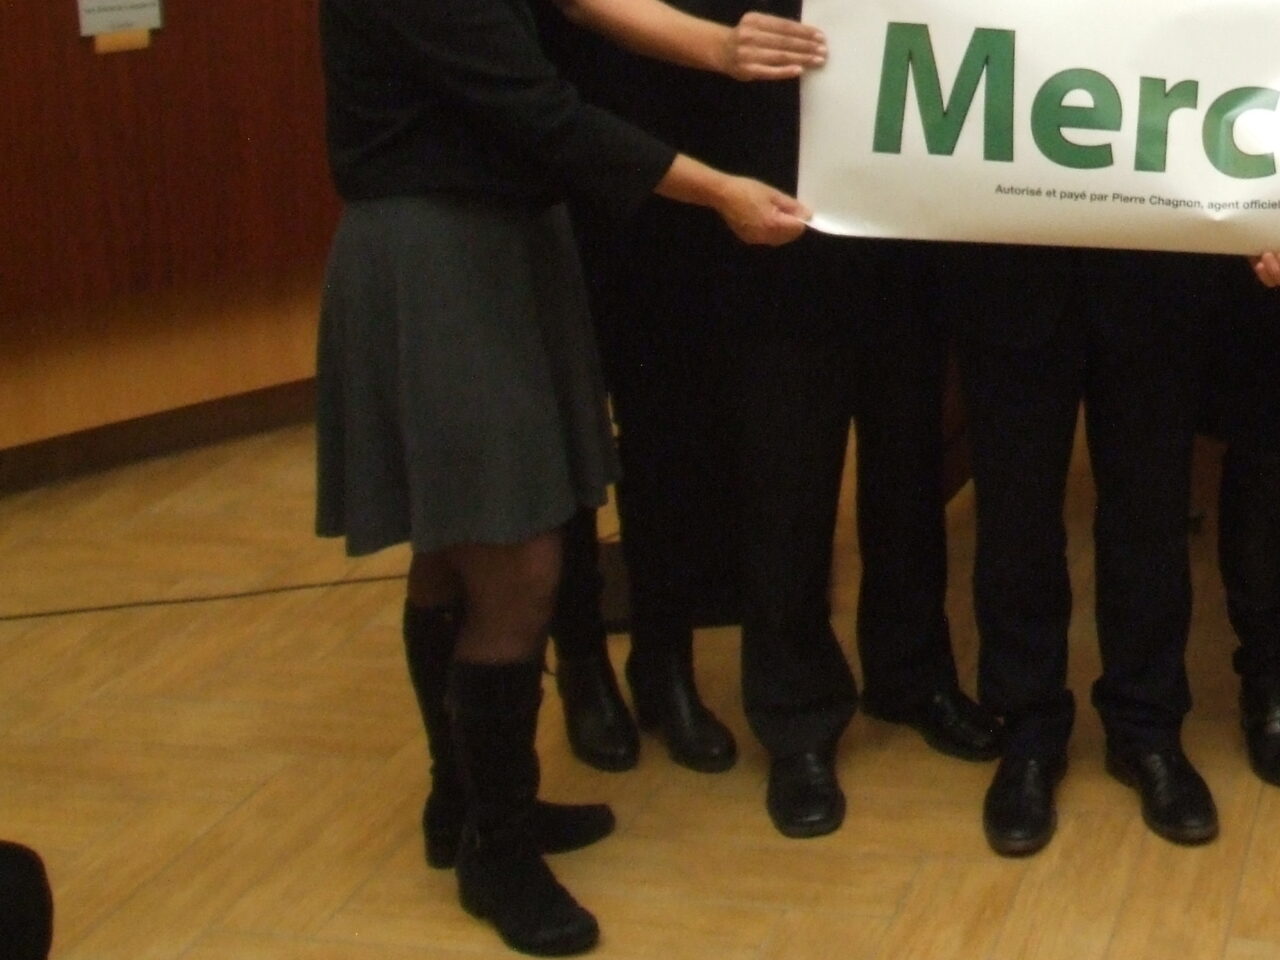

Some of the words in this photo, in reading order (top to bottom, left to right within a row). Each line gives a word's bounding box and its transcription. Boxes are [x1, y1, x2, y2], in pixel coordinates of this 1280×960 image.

[995, 184, 1042, 197] Autorisé
[1045, 188, 1056, 198] et
[1059, 189, 1087, 201] payé
[1090, 193, 1108, 203] par
[1112, 192, 1145, 204] Pierre
[1149, 195, 1204, 209] Chagnon,
[1207, 199, 1239, 212] agent
[1243, 199, 1280, 210] officiel
